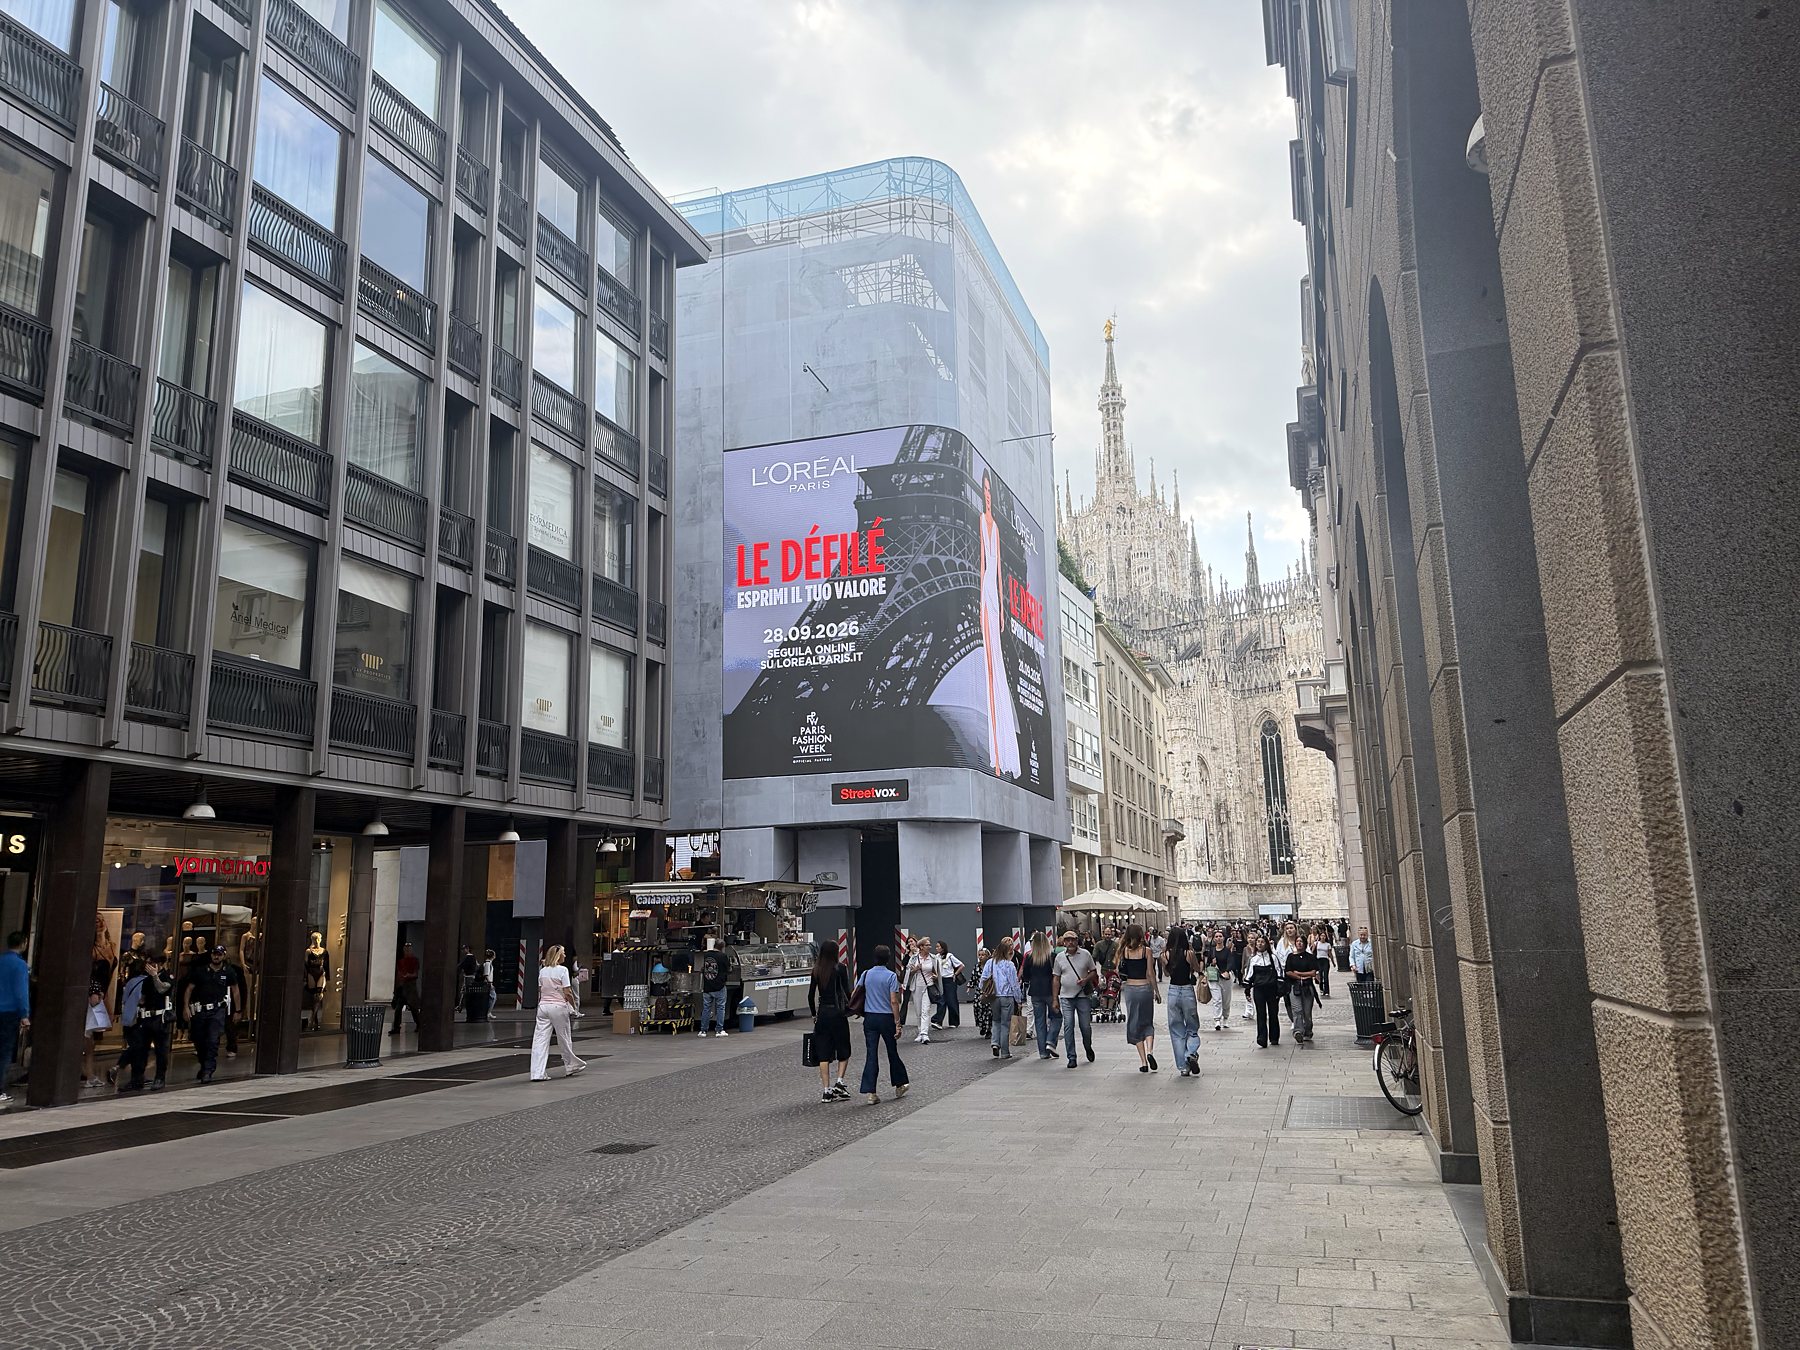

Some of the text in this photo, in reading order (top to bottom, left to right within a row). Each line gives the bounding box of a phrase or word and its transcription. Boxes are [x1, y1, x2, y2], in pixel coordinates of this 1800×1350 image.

[752, 455, 868, 486] L'ORÉAL
[737, 516, 885, 587] LE DÉFILÉ
[737, 576, 887, 609] ESPRIMI IL TUO VALORE
[1009, 574, 1019, 618] LE
[254, 616, 289, 635] Medical
[763, 620, 859, 644] 28.09.2026
[767, 642, 856, 659] SEGUILA ONLINE
[760, 652, 863, 670] SU LOREALPARIS.IT
[792, 734, 832, 745] FASHION
[800, 725, 826, 736] PARIS
[799, 744, 826, 754] WEEK
